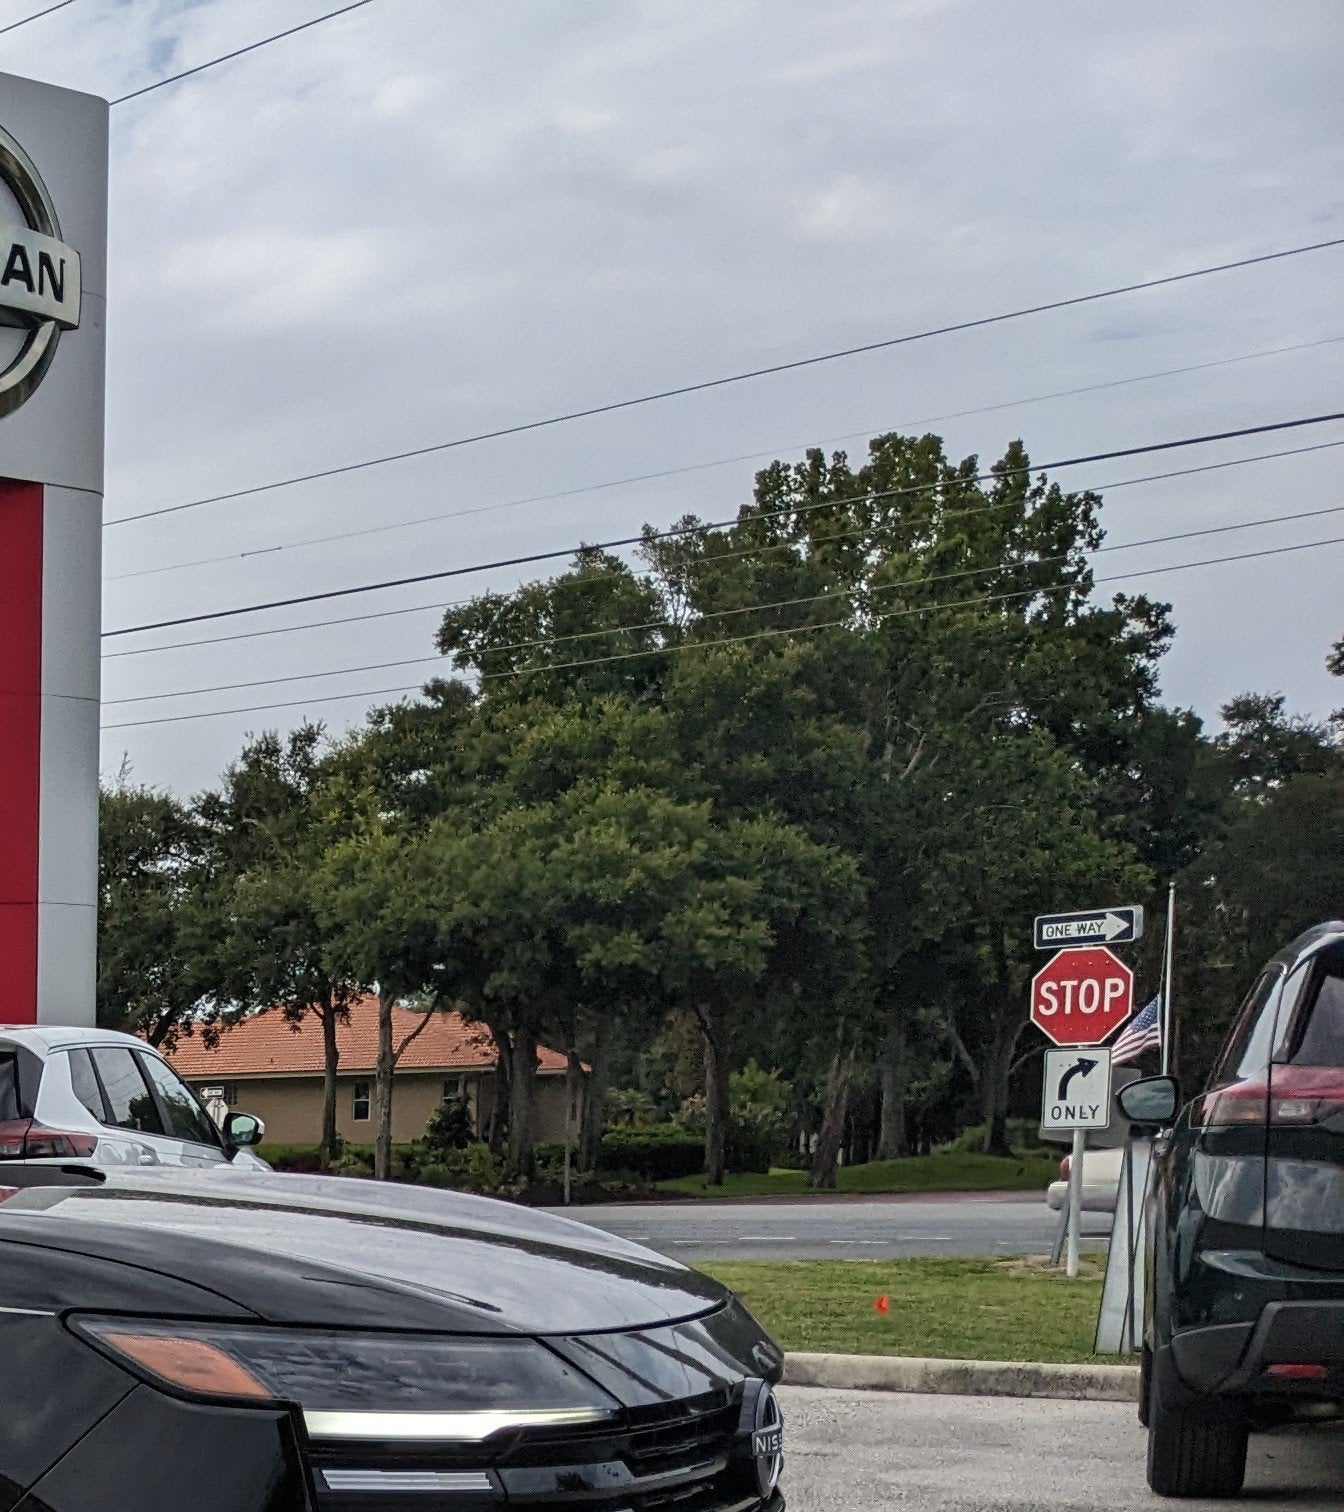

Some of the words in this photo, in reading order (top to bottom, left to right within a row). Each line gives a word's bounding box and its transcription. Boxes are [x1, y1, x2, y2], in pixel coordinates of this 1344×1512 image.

[1045, 923, 1072, 939] ONE
[1076, 921, 1105, 936] WAY
[1038, 977, 1125, 1016] STOP
[1050, 1104, 1100, 1121] ONLY
